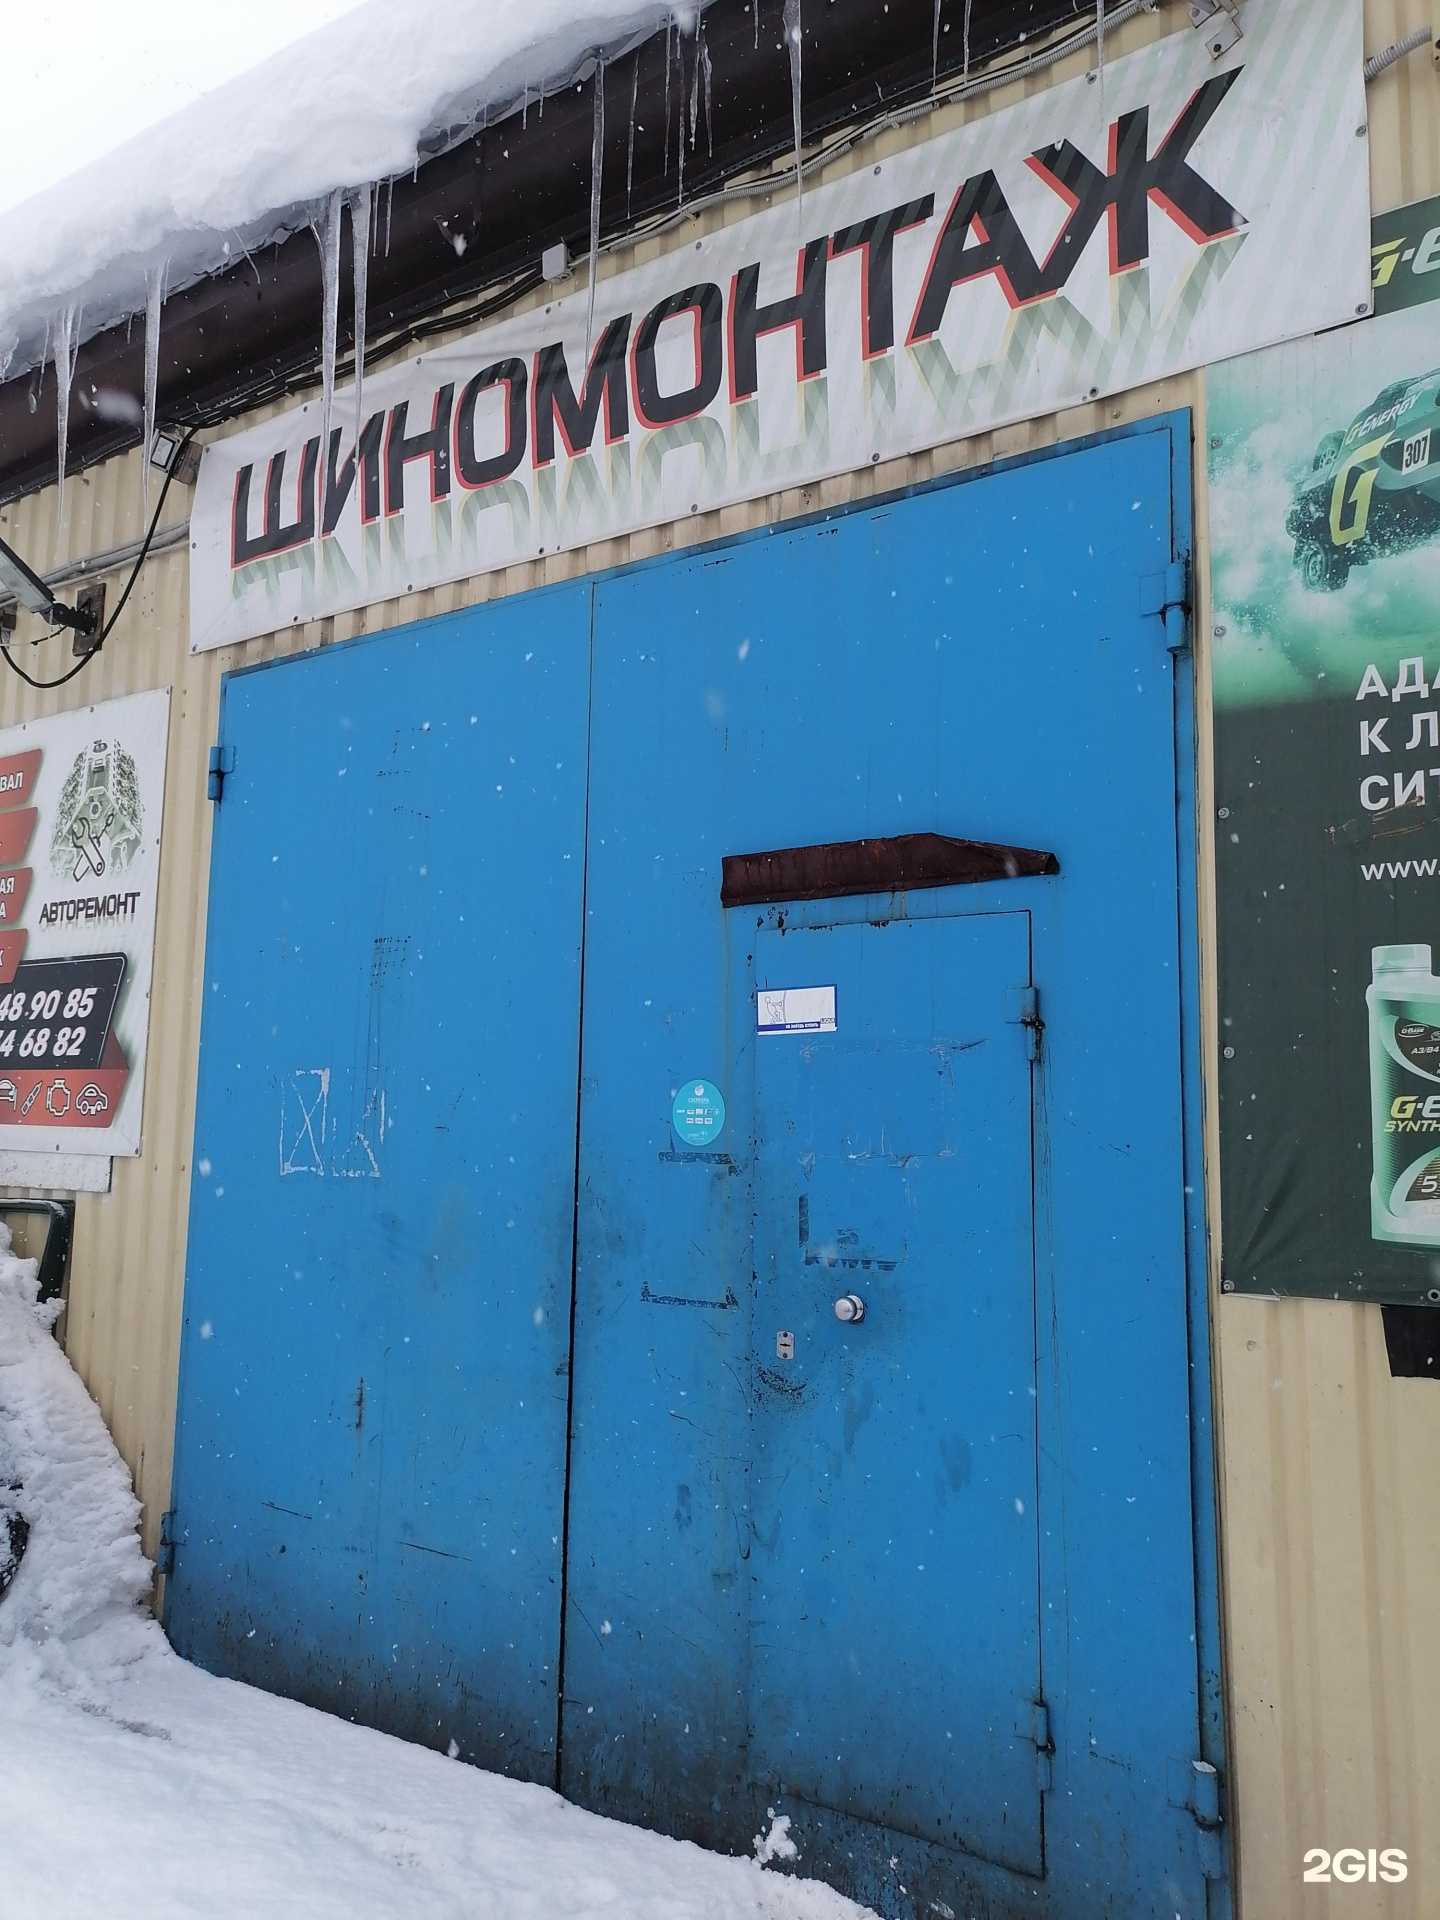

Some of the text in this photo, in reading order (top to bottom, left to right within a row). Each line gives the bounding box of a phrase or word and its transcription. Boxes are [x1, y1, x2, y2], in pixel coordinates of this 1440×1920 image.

[231, 64, 1248, 568] ШИНОМОНТАЖ
[1404, 435, 1429, 469] 307
[1355, 655, 1440, 703] АД
[1359, 717, 1391, 756] К
[39, 891, 141, 925] АВТОРЕМОНТ
[29, 989, 61, 1020] 90
[62, 987, 98, 1019] 85
[19, 1027, 51, 1058] 68
[52, 1026, 86, 1057] 82
